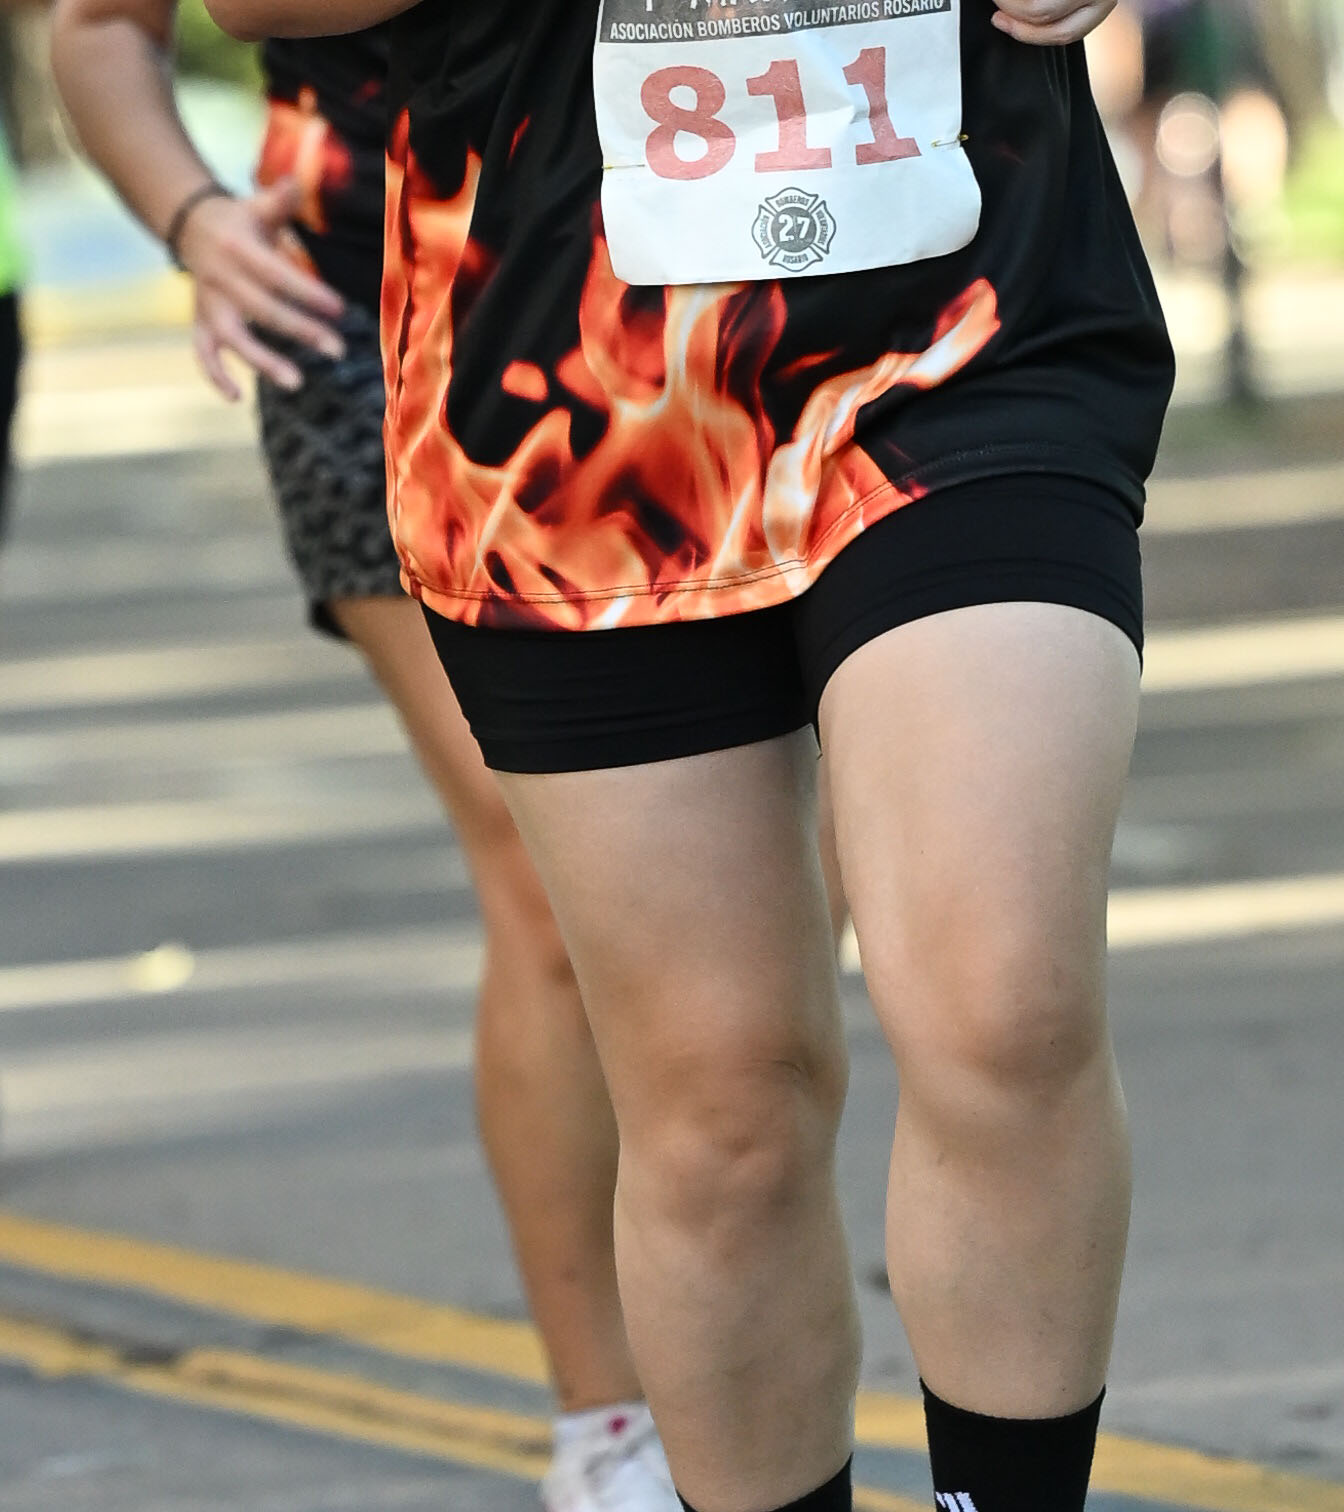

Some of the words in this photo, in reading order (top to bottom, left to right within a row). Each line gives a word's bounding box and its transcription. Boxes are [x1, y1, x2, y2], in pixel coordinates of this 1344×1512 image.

[610, 18, 694, 40] ASOCIACIÓN
[697, 14, 780, 36] BOMBEROS
[784, 1, 880, 29] VOLUNTARIOS
[640, 46, 922, 181] 811
[778, 213, 810, 241] 27
